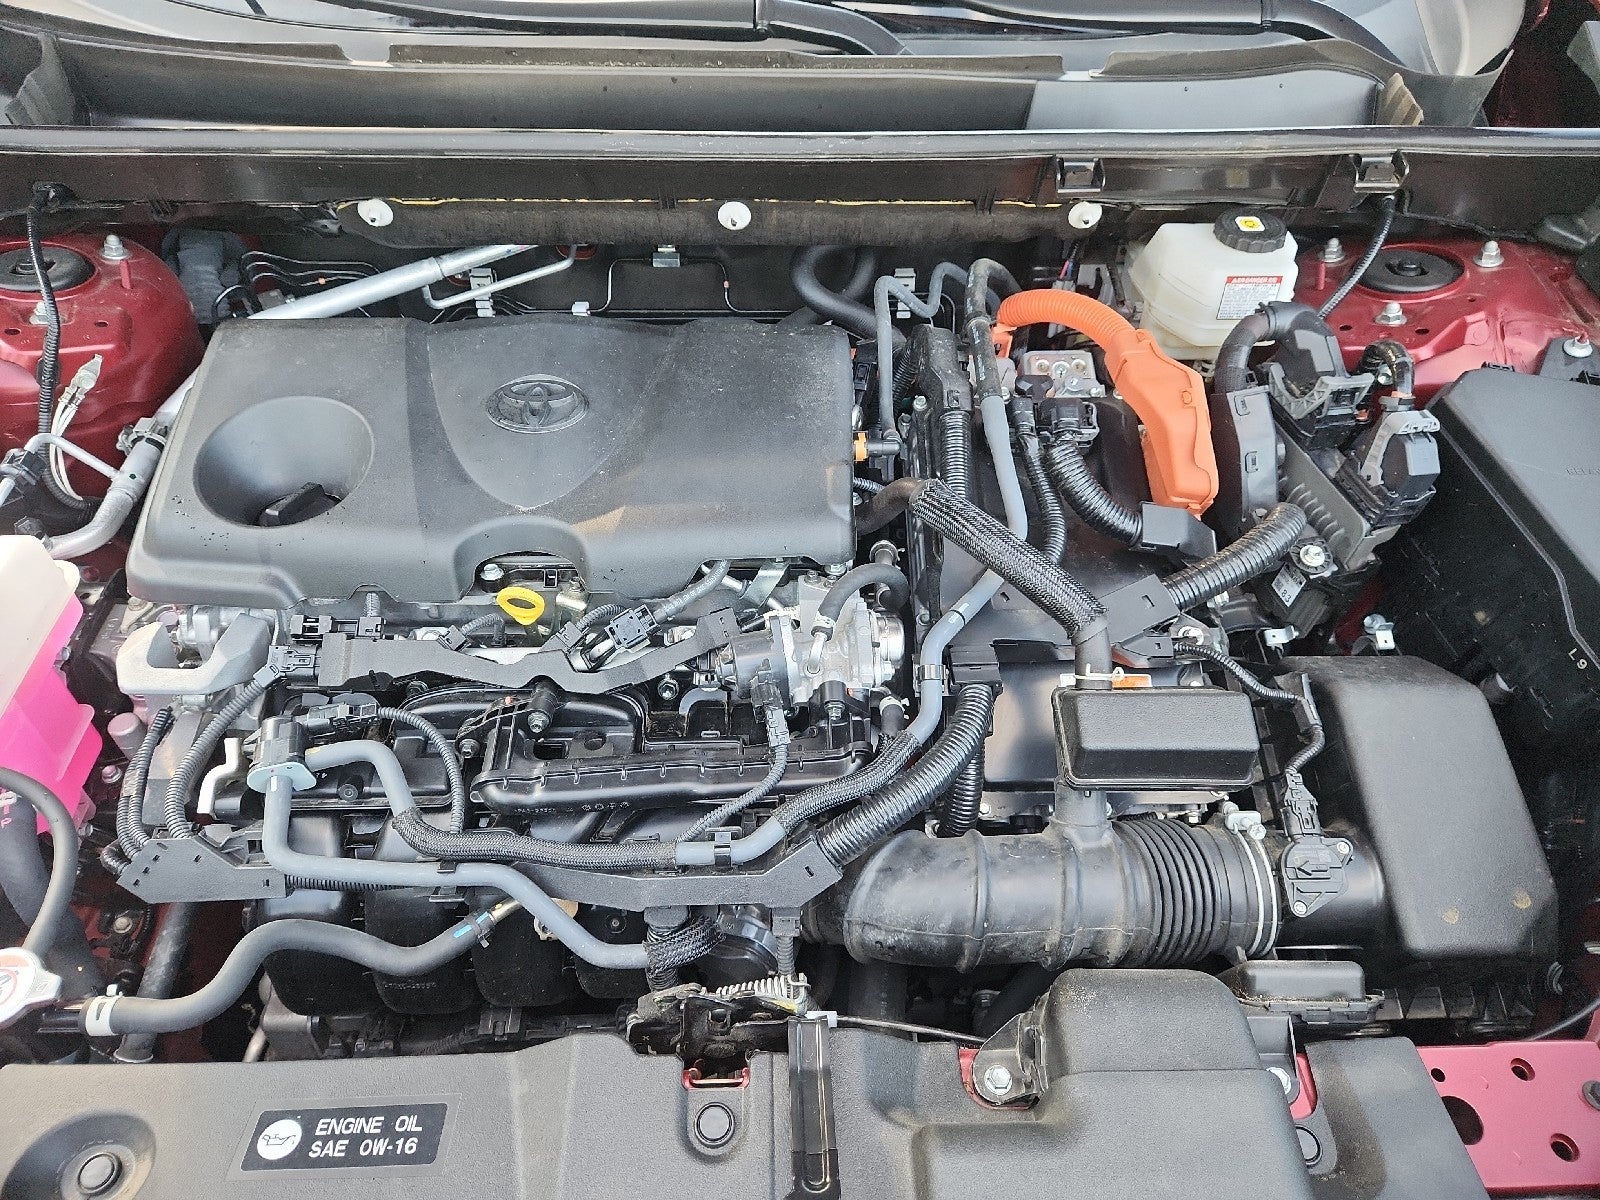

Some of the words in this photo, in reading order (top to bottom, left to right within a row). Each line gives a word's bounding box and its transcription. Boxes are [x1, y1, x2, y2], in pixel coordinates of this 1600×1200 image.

[315, 1116, 385, 1136] ENGINE
[394, 1115, 423, 1132] OIL
[308, 1139, 350, 1158] SAE
[359, 1137, 419, 1156] 0W-16
